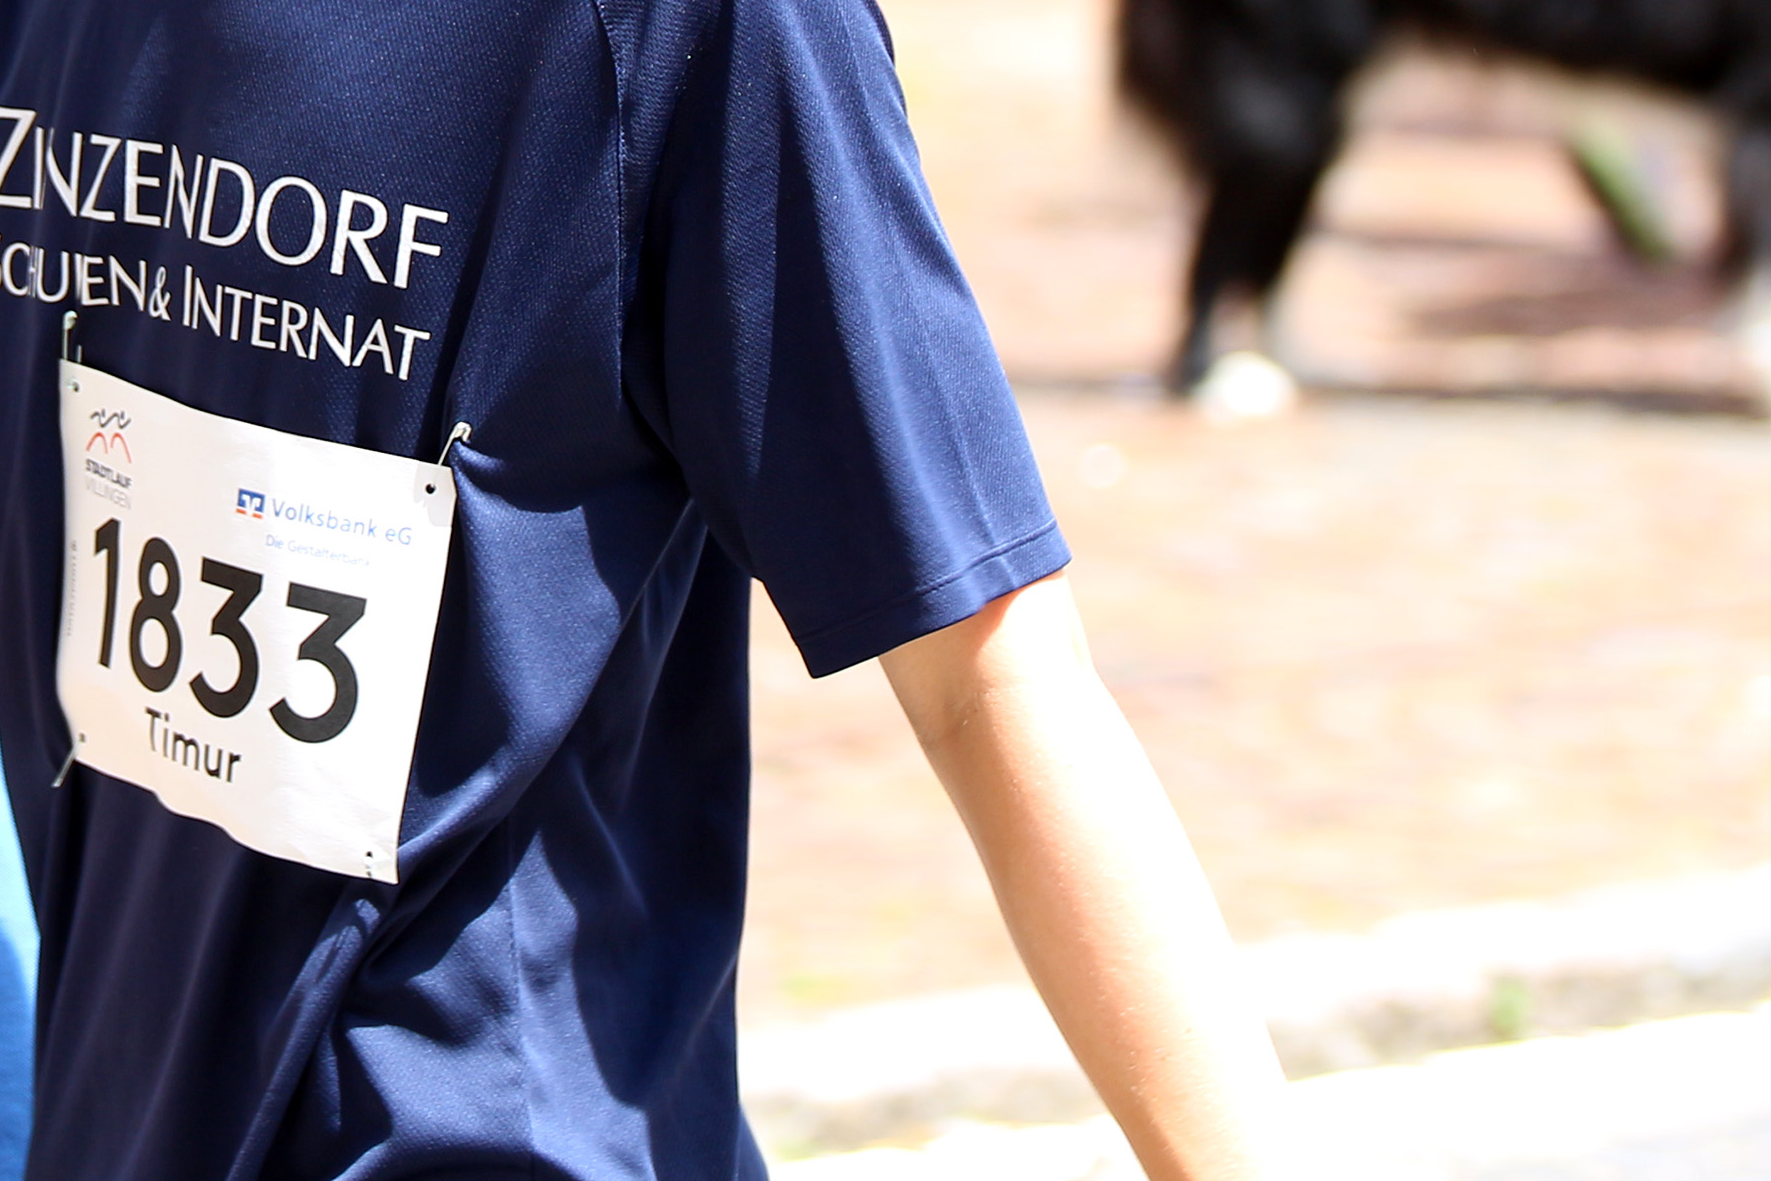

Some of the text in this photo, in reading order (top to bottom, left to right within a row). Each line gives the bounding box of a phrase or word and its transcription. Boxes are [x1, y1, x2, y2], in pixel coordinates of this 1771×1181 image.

[182, 265, 431, 382] INTERNAT
[272, 498, 412, 546] Volksbank eG
[94, 517, 368, 744] 1833
[144, 706, 242, 784] Timur
